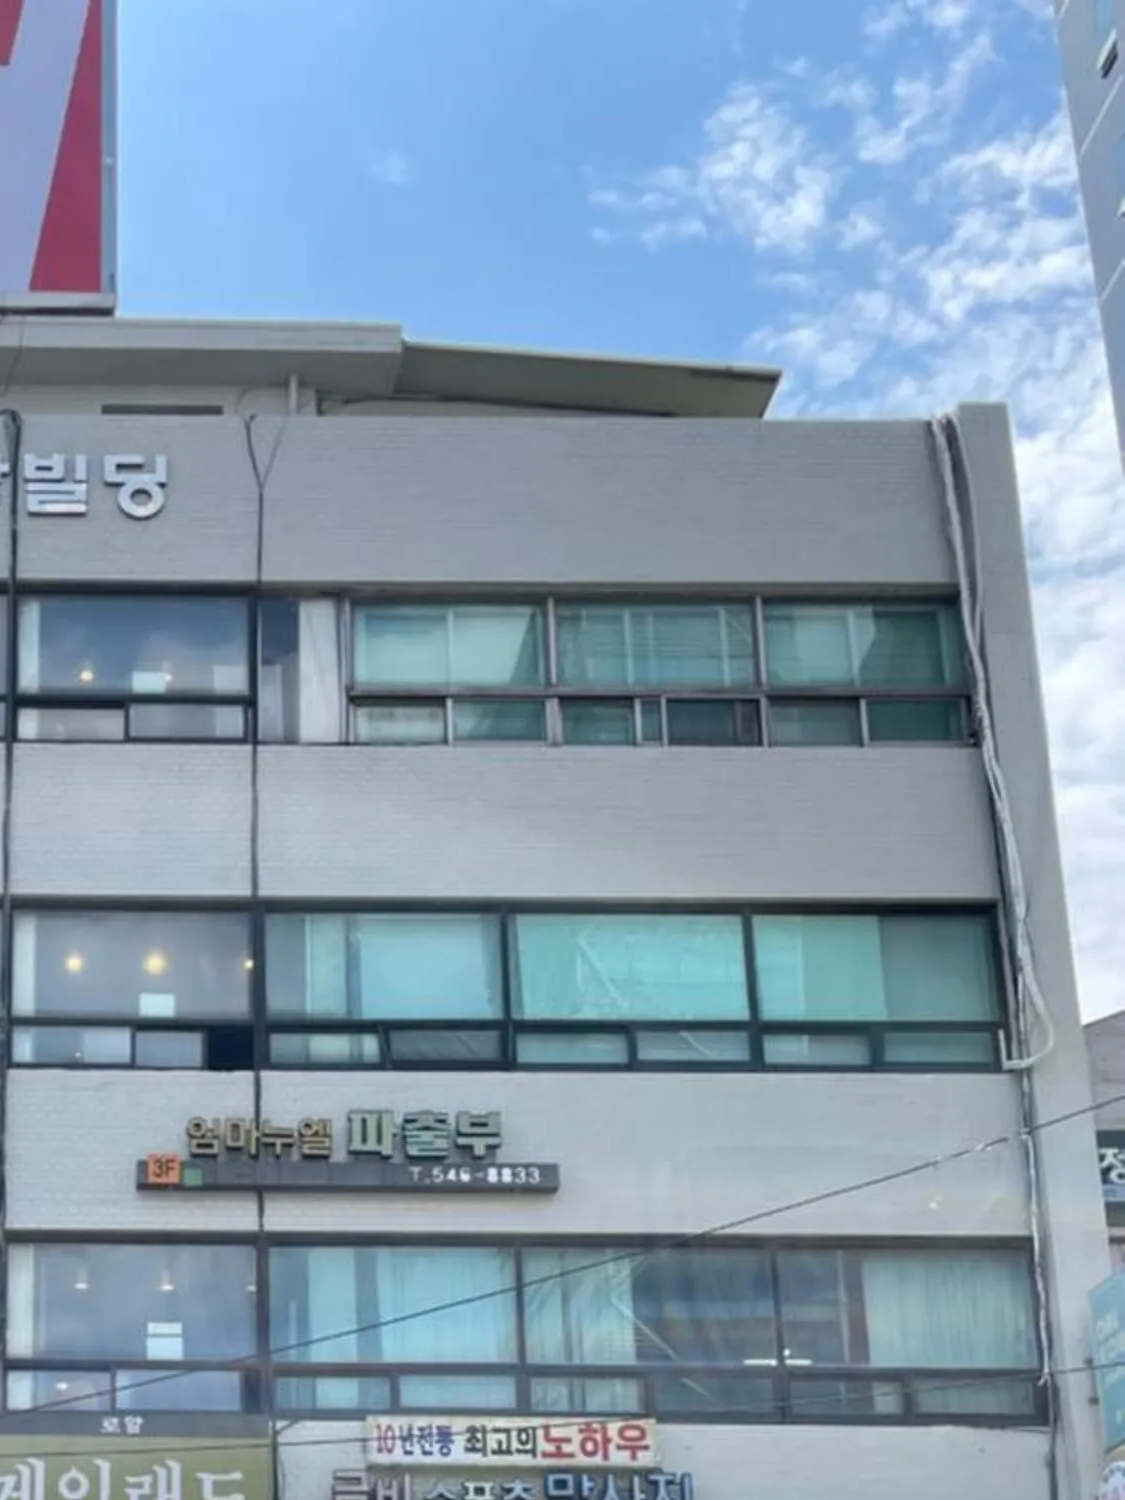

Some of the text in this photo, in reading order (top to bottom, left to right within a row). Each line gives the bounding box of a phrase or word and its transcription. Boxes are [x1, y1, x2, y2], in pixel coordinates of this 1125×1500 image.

[347, 1109, 503, 1158] 파출부
[152, 1157, 177, 1179] 3F
[464, 1424, 538, 1457] 최고의
[541, 1423, 651, 1461] 노하우
